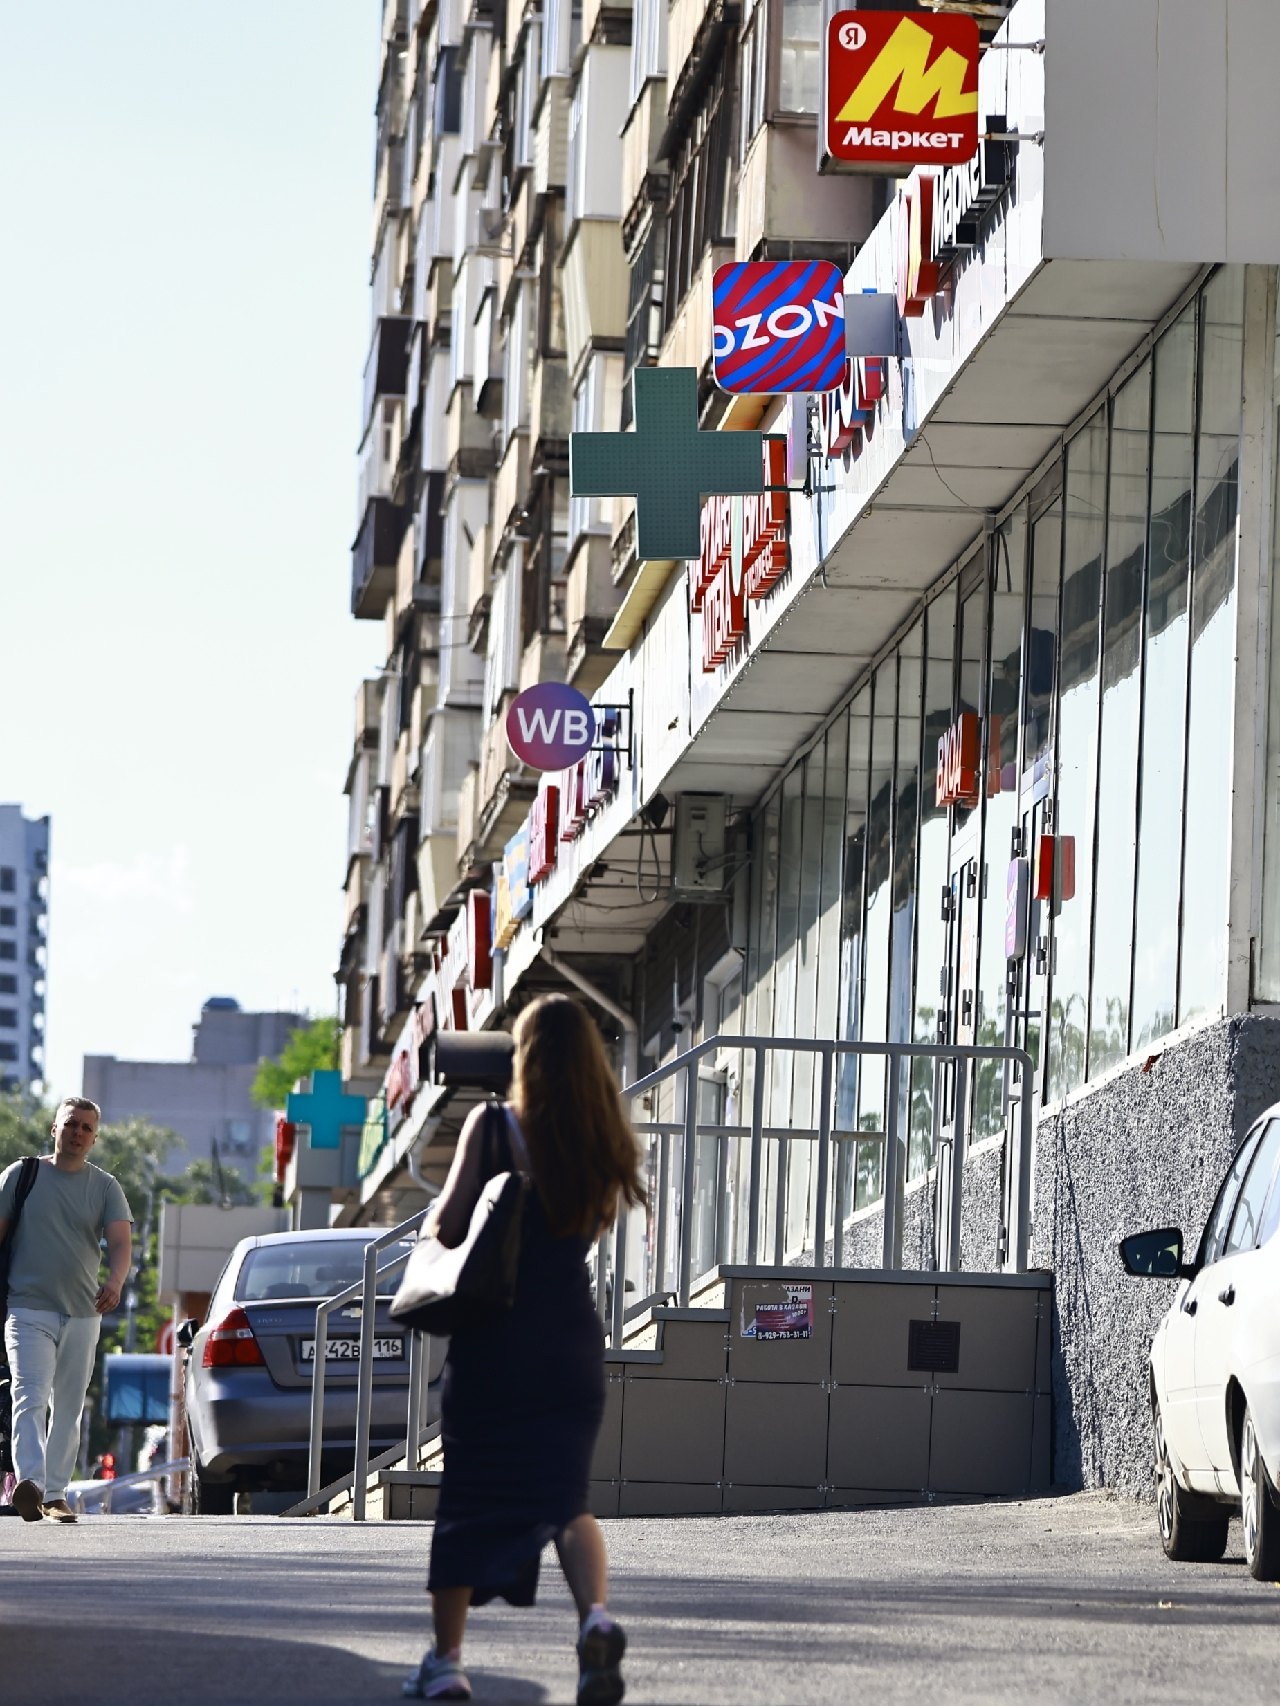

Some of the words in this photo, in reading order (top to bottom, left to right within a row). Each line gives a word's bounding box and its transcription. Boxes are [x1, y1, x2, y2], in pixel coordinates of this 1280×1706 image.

[845, 27, 859, 45] Я
[841, 126, 964, 150] Маркет
[713, 292, 845, 358] OZON
[702, 558, 733, 672] АПТЕКА
[516, 707, 589, 746] WB
[935, 713, 963, 808] ВХОД
[374, 1340, 400, 1353] 116
